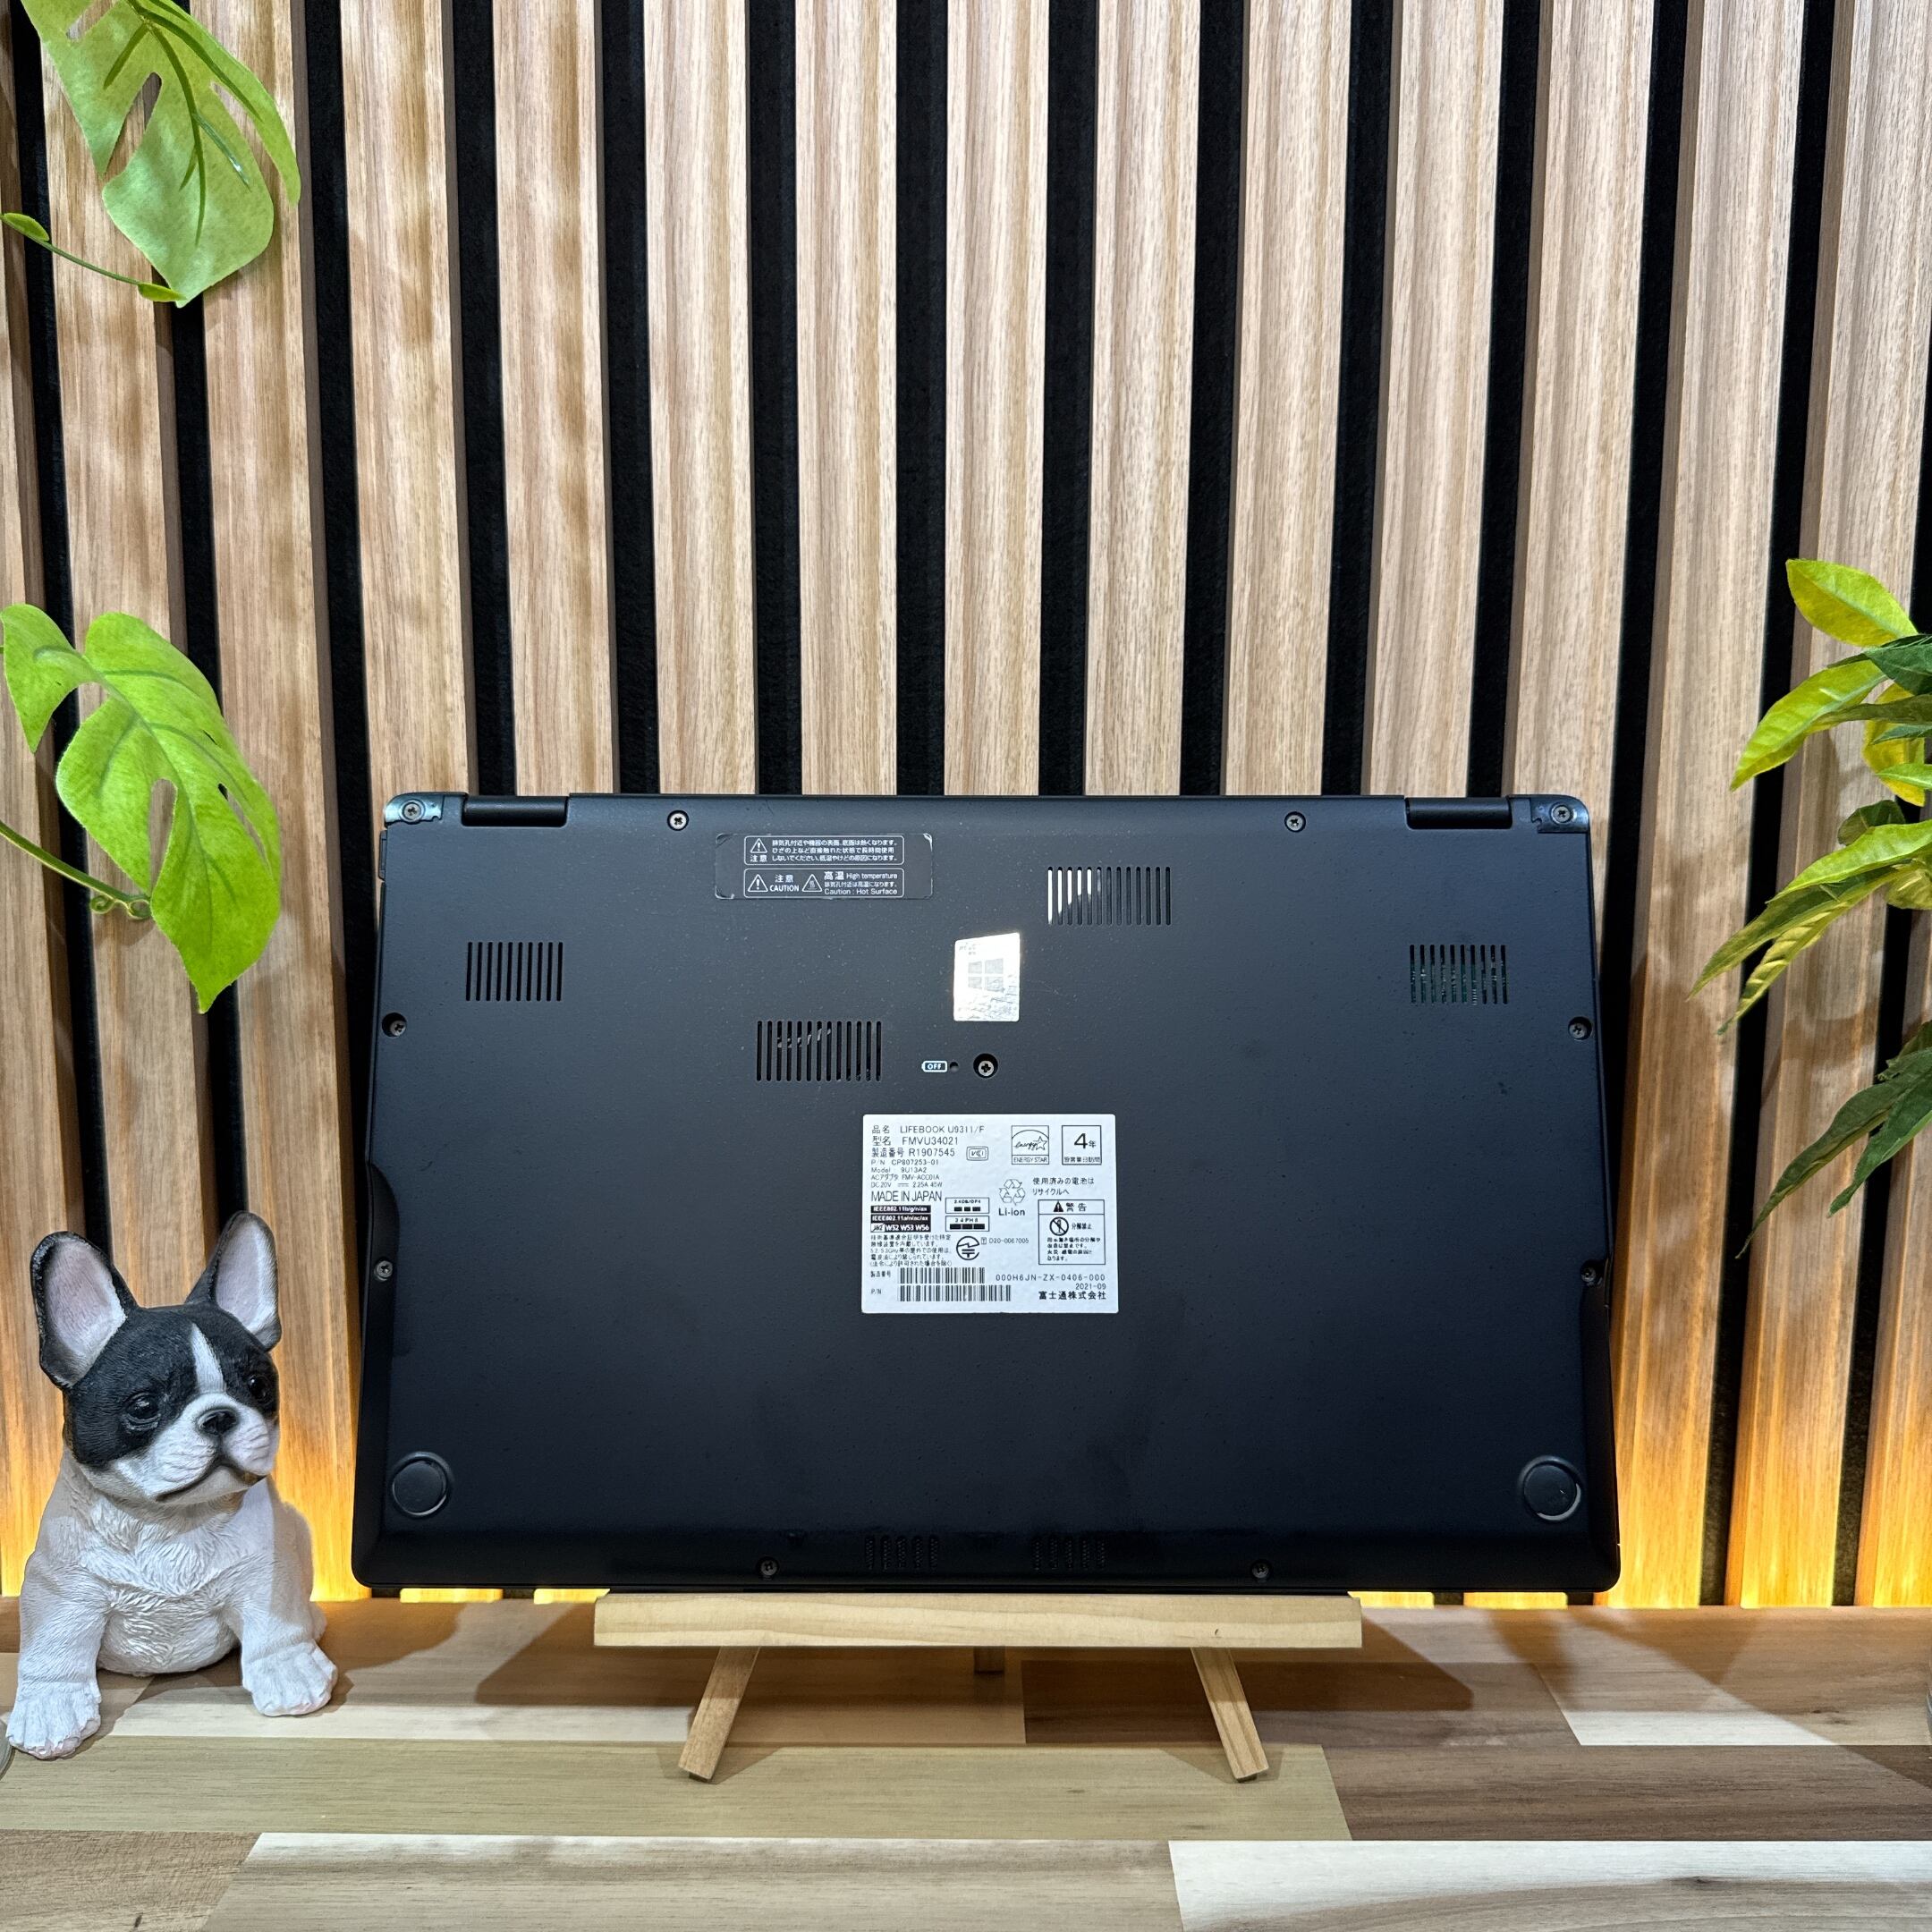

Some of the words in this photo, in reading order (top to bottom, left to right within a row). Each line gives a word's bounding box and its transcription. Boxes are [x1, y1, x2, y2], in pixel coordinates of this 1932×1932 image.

[775, 874, 794, 883] 注意
[824, 871, 844, 880] 高温
[871, 1125, 890, 1134] 品名
[947, 1125, 985, 1134] U9311/F
[872, 1136, 891, 1146] 型名
[902, 1137, 958, 1145] FMVU34021
[908, 1148, 955, 1157] R1907545
[1032, 1177, 1095, 1185] 使用済みの電池は
[871, 1191, 899, 1202] MADE
[901, 1191, 911, 1202] IN
[912, 1191, 943, 1202] JAPAN
[1065, 1202, 1087, 1212] 警告
[998, 1208, 1026, 1216] Li-ion
[1038, 1291, 1106, 1301] 富士通株式会社
